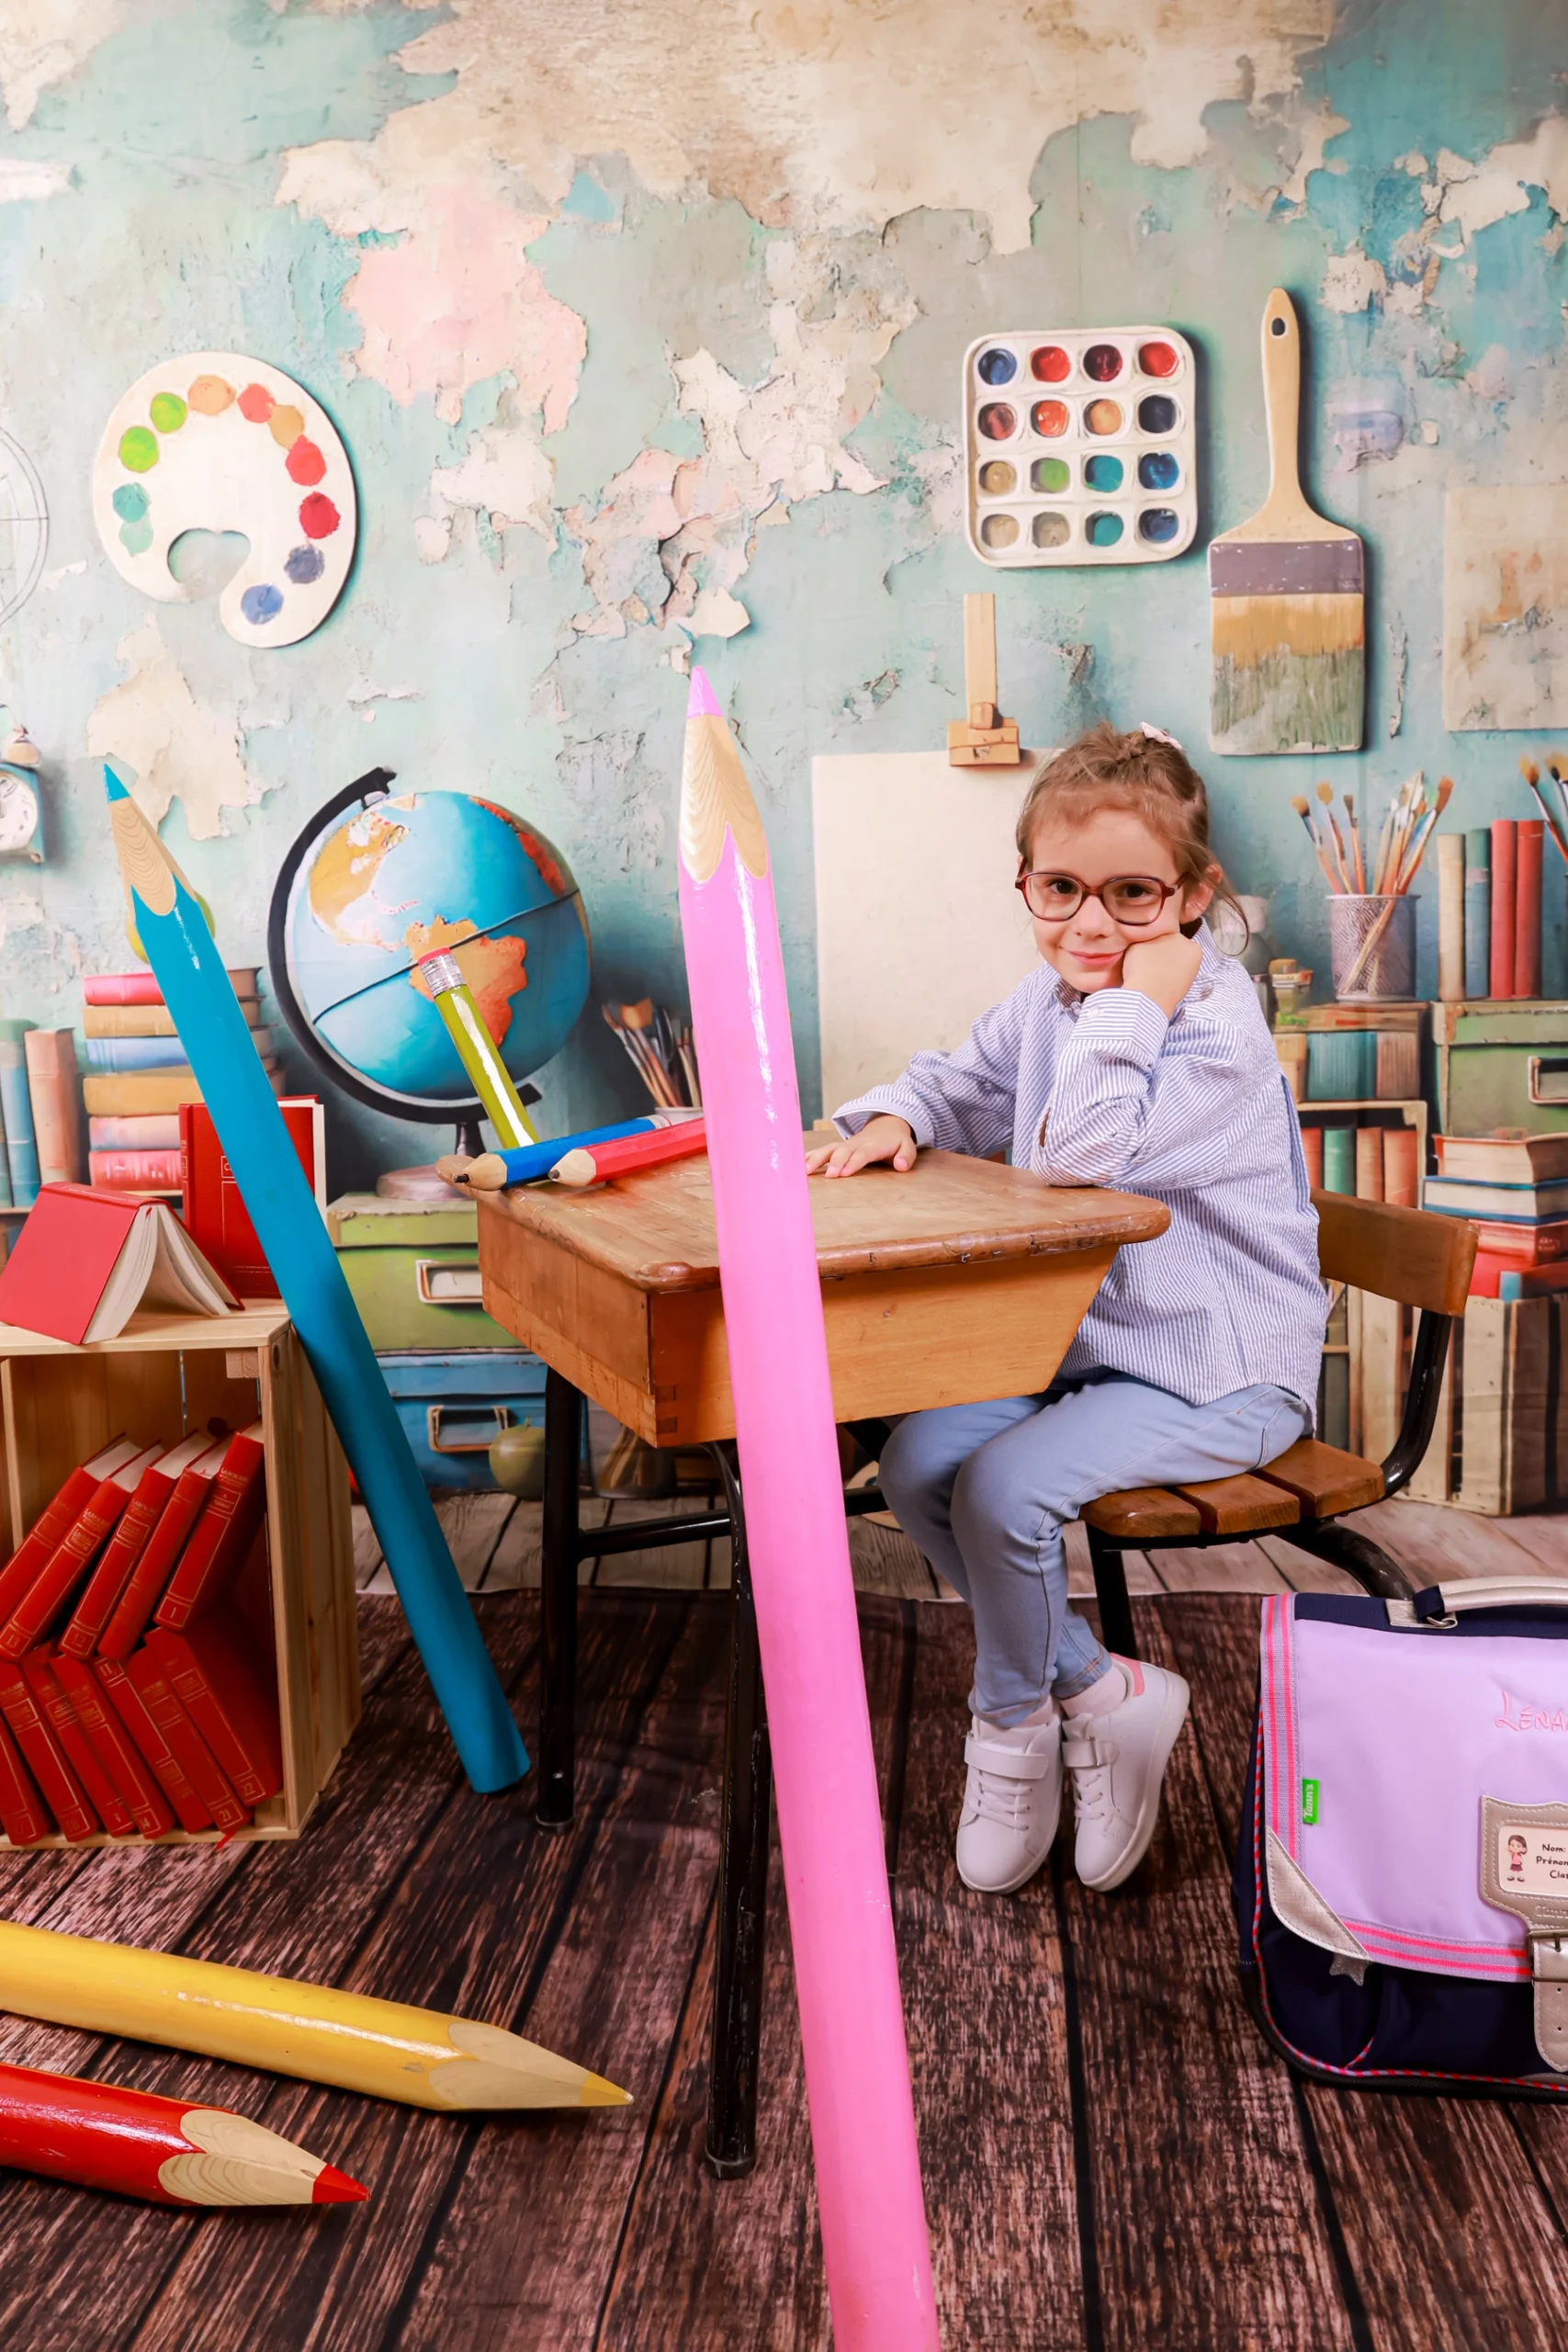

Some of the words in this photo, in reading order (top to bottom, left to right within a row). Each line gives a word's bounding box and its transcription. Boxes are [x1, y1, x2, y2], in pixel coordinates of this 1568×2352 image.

[169, 1607, 177, 1619] 1
[5, 1634, 20, 1648] 13
[71, 1633, 86, 1648] 12
[1495, 1690, 1568, 1732] LÉNA
[1303, 1783, 1314, 1819] Tann's
[219, 1809, 232, 1823] 21
[1541, 1843, 1566, 1853] Nom:
